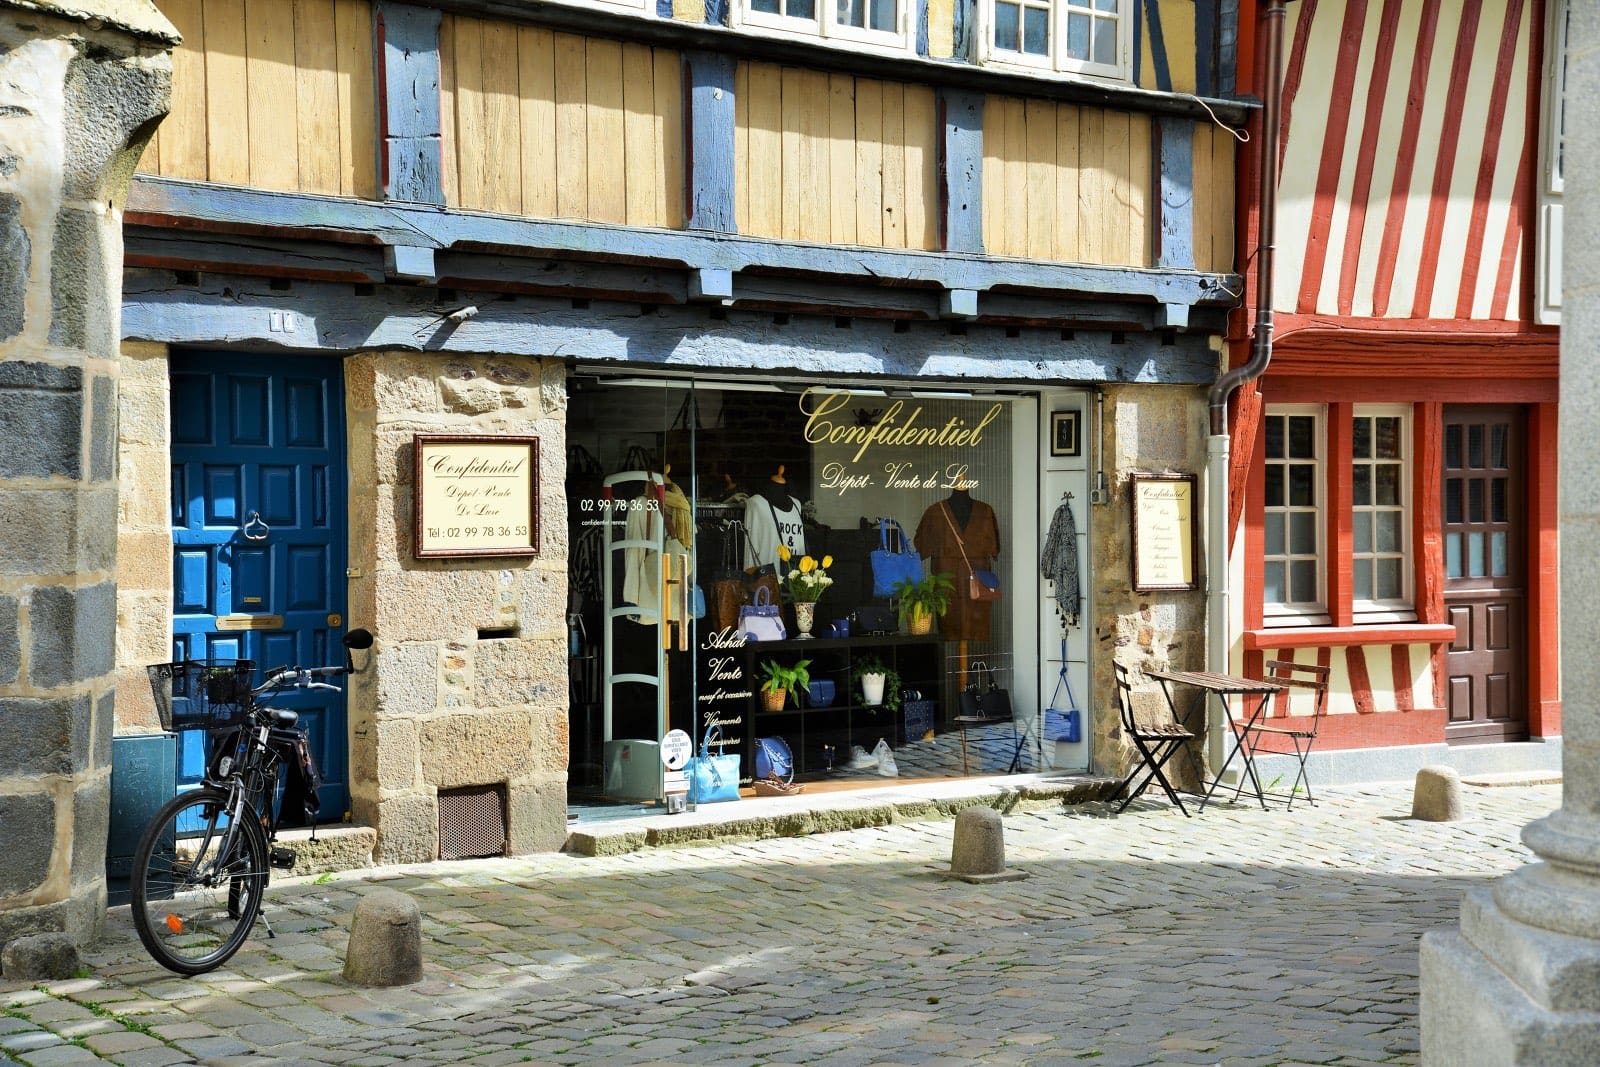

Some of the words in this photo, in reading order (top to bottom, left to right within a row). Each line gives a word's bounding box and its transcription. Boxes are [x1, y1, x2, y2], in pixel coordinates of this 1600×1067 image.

[800, 386, 1002, 463] Confidentiel
[427, 455, 526, 479] Confidentiel
[885, 462, 920, 489] Vente
[923, 471, 938, 489] de
[941, 463, 979, 489] Luxe
[580, 499, 594, 511] 02
[597, 499, 611, 511] 99
[615, 499, 627, 511] 78
[630, 499, 643, 511] 36
[646, 499, 659, 511] 53
[447, 528, 460, 538] 02
[465, 527, 478, 537] 99
[482, 527, 494, 537] 78
[498, 526, 511, 537] 36
[515, 526, 527, 536] 53
[780, 522, 802, 535] ROCK
[701, 625, 748, 650] Achat
[708, 656, 742, 681] Vente
[698, 687, 722, 705] neuf
